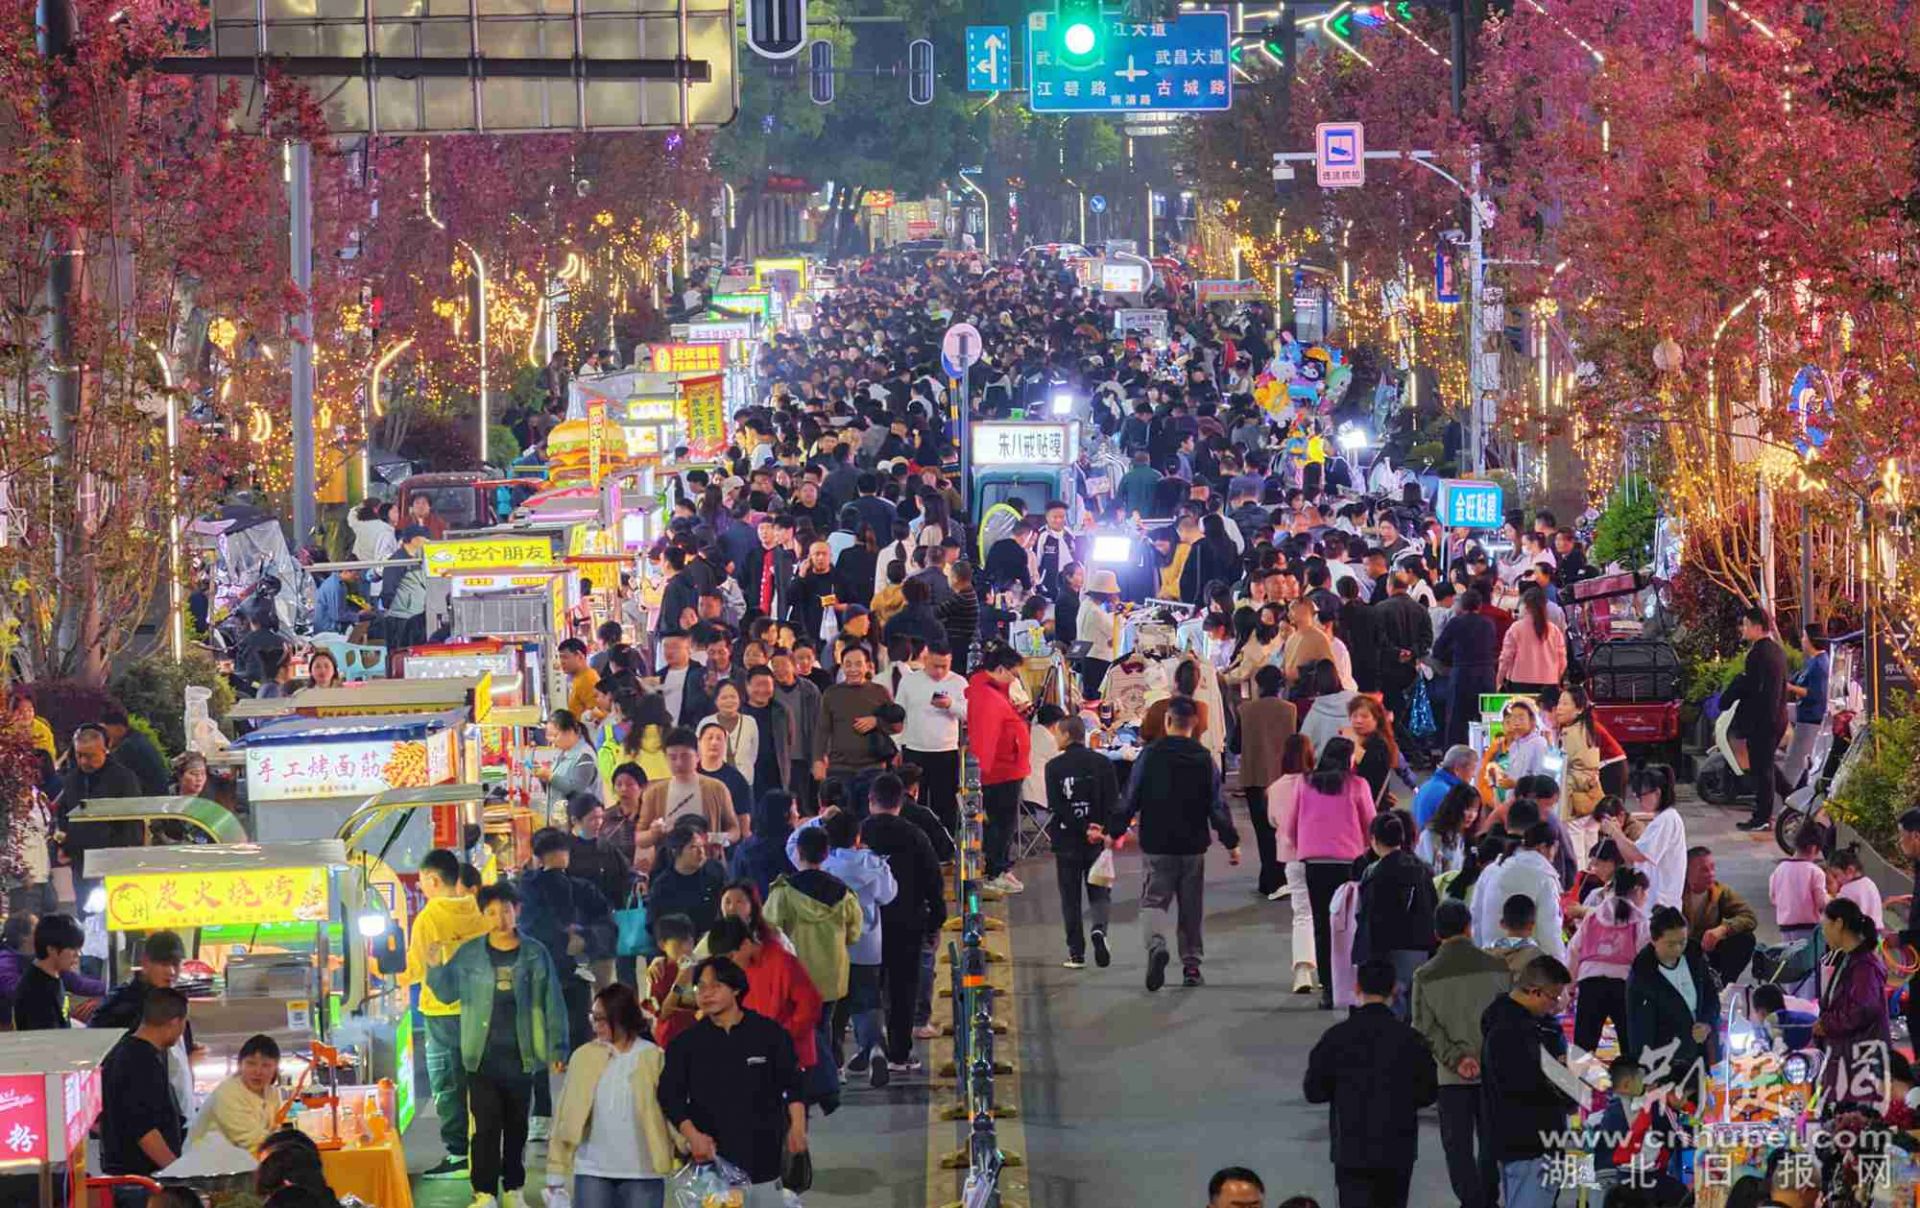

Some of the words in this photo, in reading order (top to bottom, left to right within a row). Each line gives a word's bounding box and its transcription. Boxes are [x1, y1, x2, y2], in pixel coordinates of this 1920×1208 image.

[1155, 49, 1224, 65] 武昌大道
[1156, 80, 1226, 97] 古城路
[1455, 491, 1497, 522] 金旺贴膜
[457, 545, 545, 562] 饺个朋友
[257, 751, 381, 783] 手工烤面筋
[5, 1123, 39, 1152] 粉
